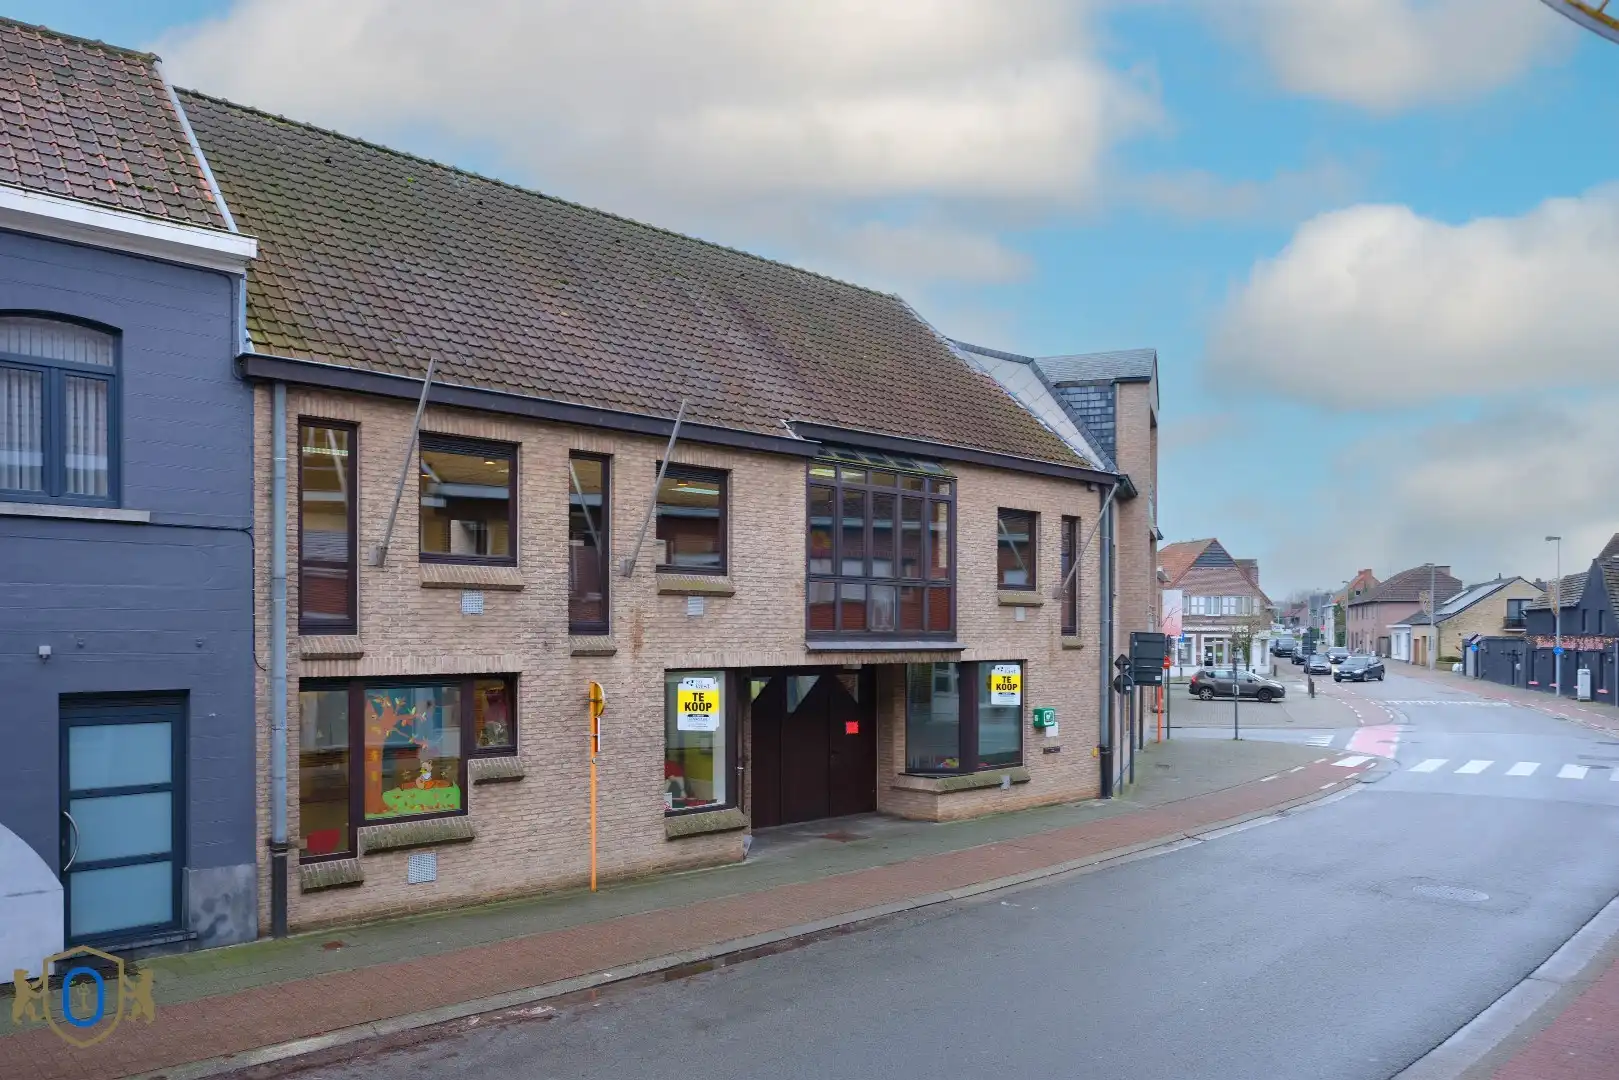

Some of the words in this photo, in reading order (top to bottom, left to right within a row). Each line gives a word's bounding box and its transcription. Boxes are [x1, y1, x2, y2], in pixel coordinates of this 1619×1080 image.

[1002, 676, 1012, 684] TE
[995, 683, 1018, 691] KOOP
[692, 692, 705, 702] TE
[684, 702, 712, 712] KOOP
